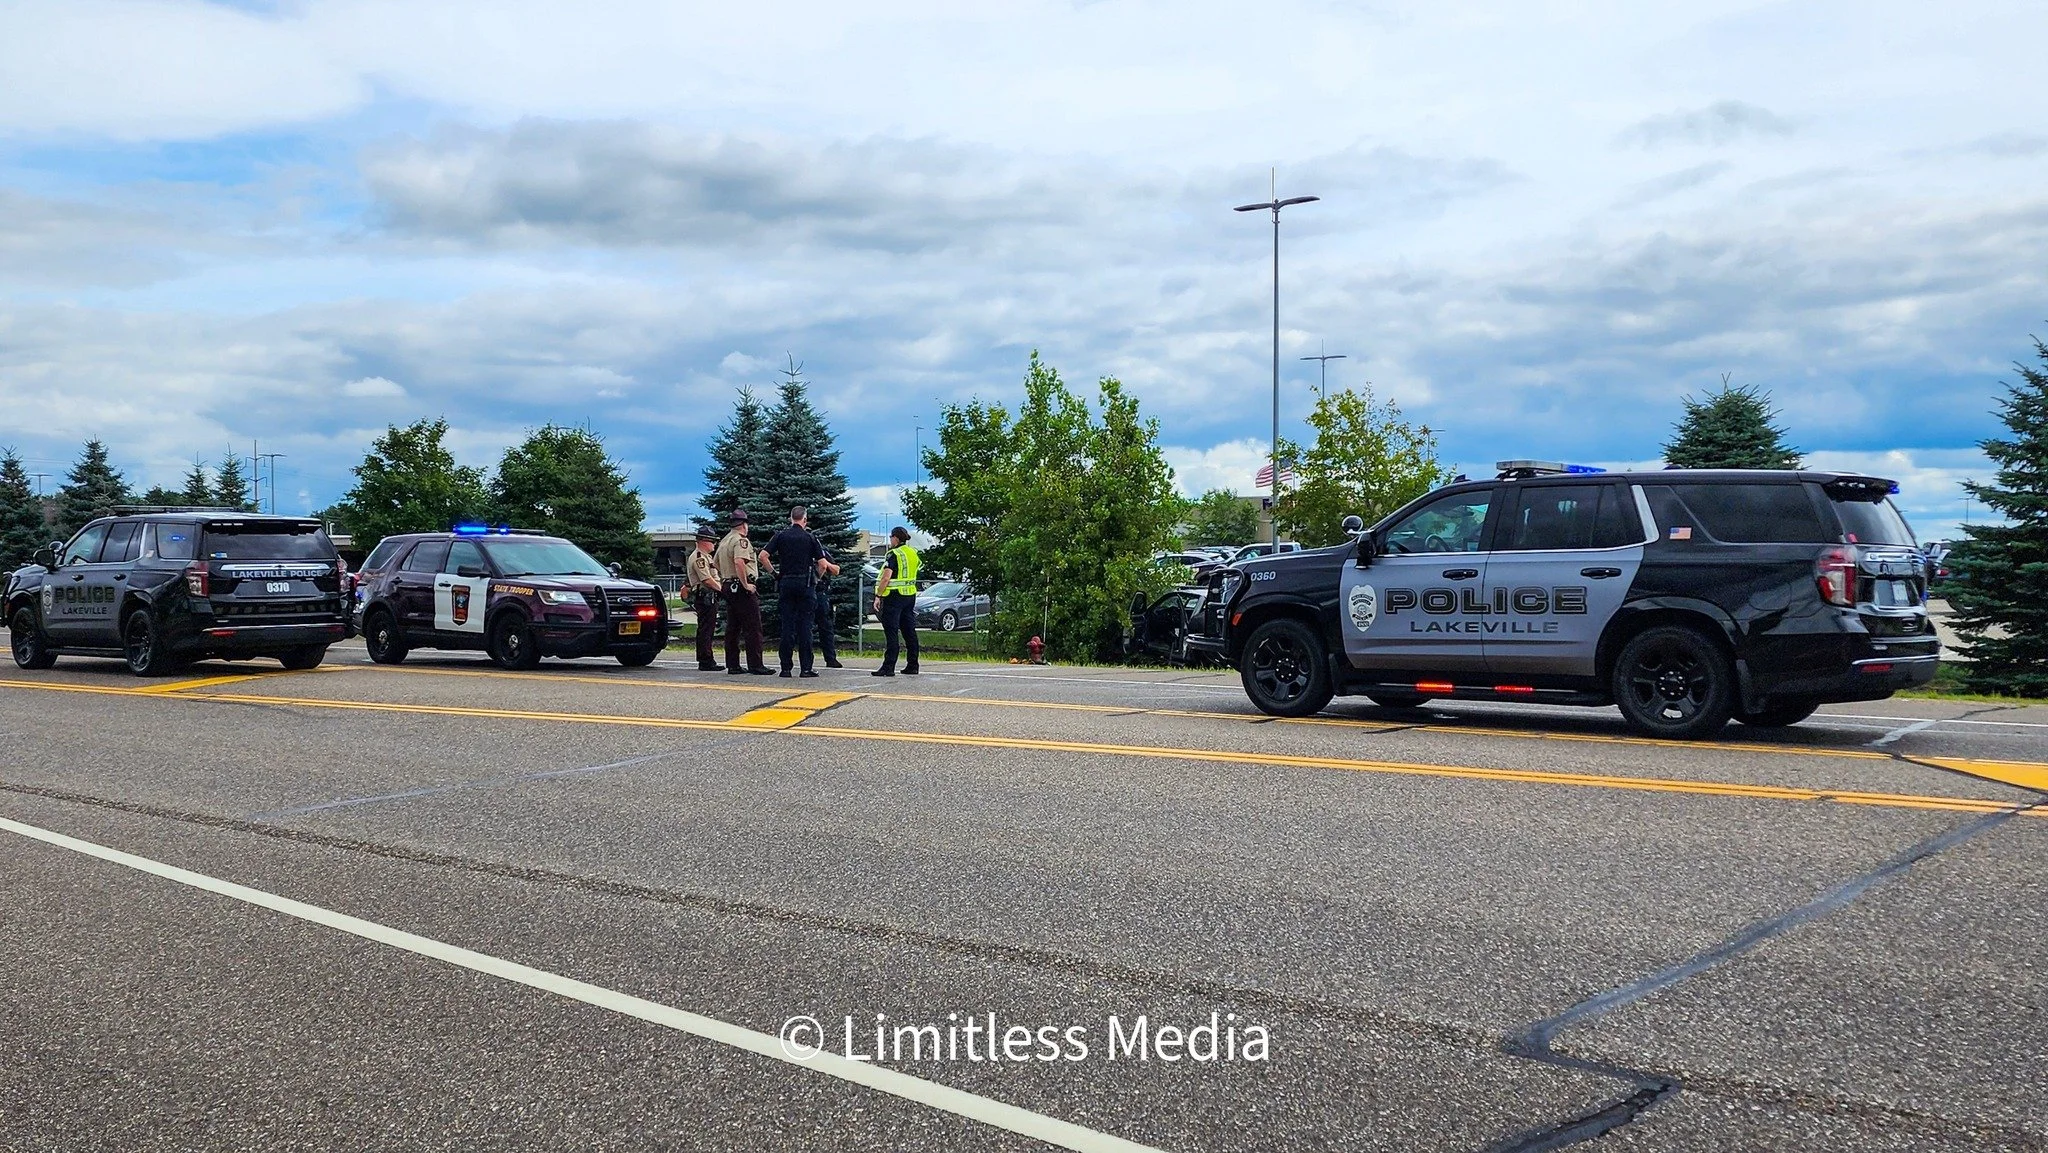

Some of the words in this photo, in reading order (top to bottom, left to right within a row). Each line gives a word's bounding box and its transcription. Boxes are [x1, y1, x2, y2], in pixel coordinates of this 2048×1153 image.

[232, 570, 287, 578] LAKEVILLE
[1251, 571, 1276, 581] 0360
[266, 582, 290, 593] 0370
[493, 584, 508, 592] STATE
[509, 586, 534, 596] TROOPER
[54, 585, 115, 603] POLICE
[1385, 587, 1587, 614] POLICE
[62, 607, 107, 615] LAKEVILLE
[1411, 621, 1558, 633] LAKEVILLE
